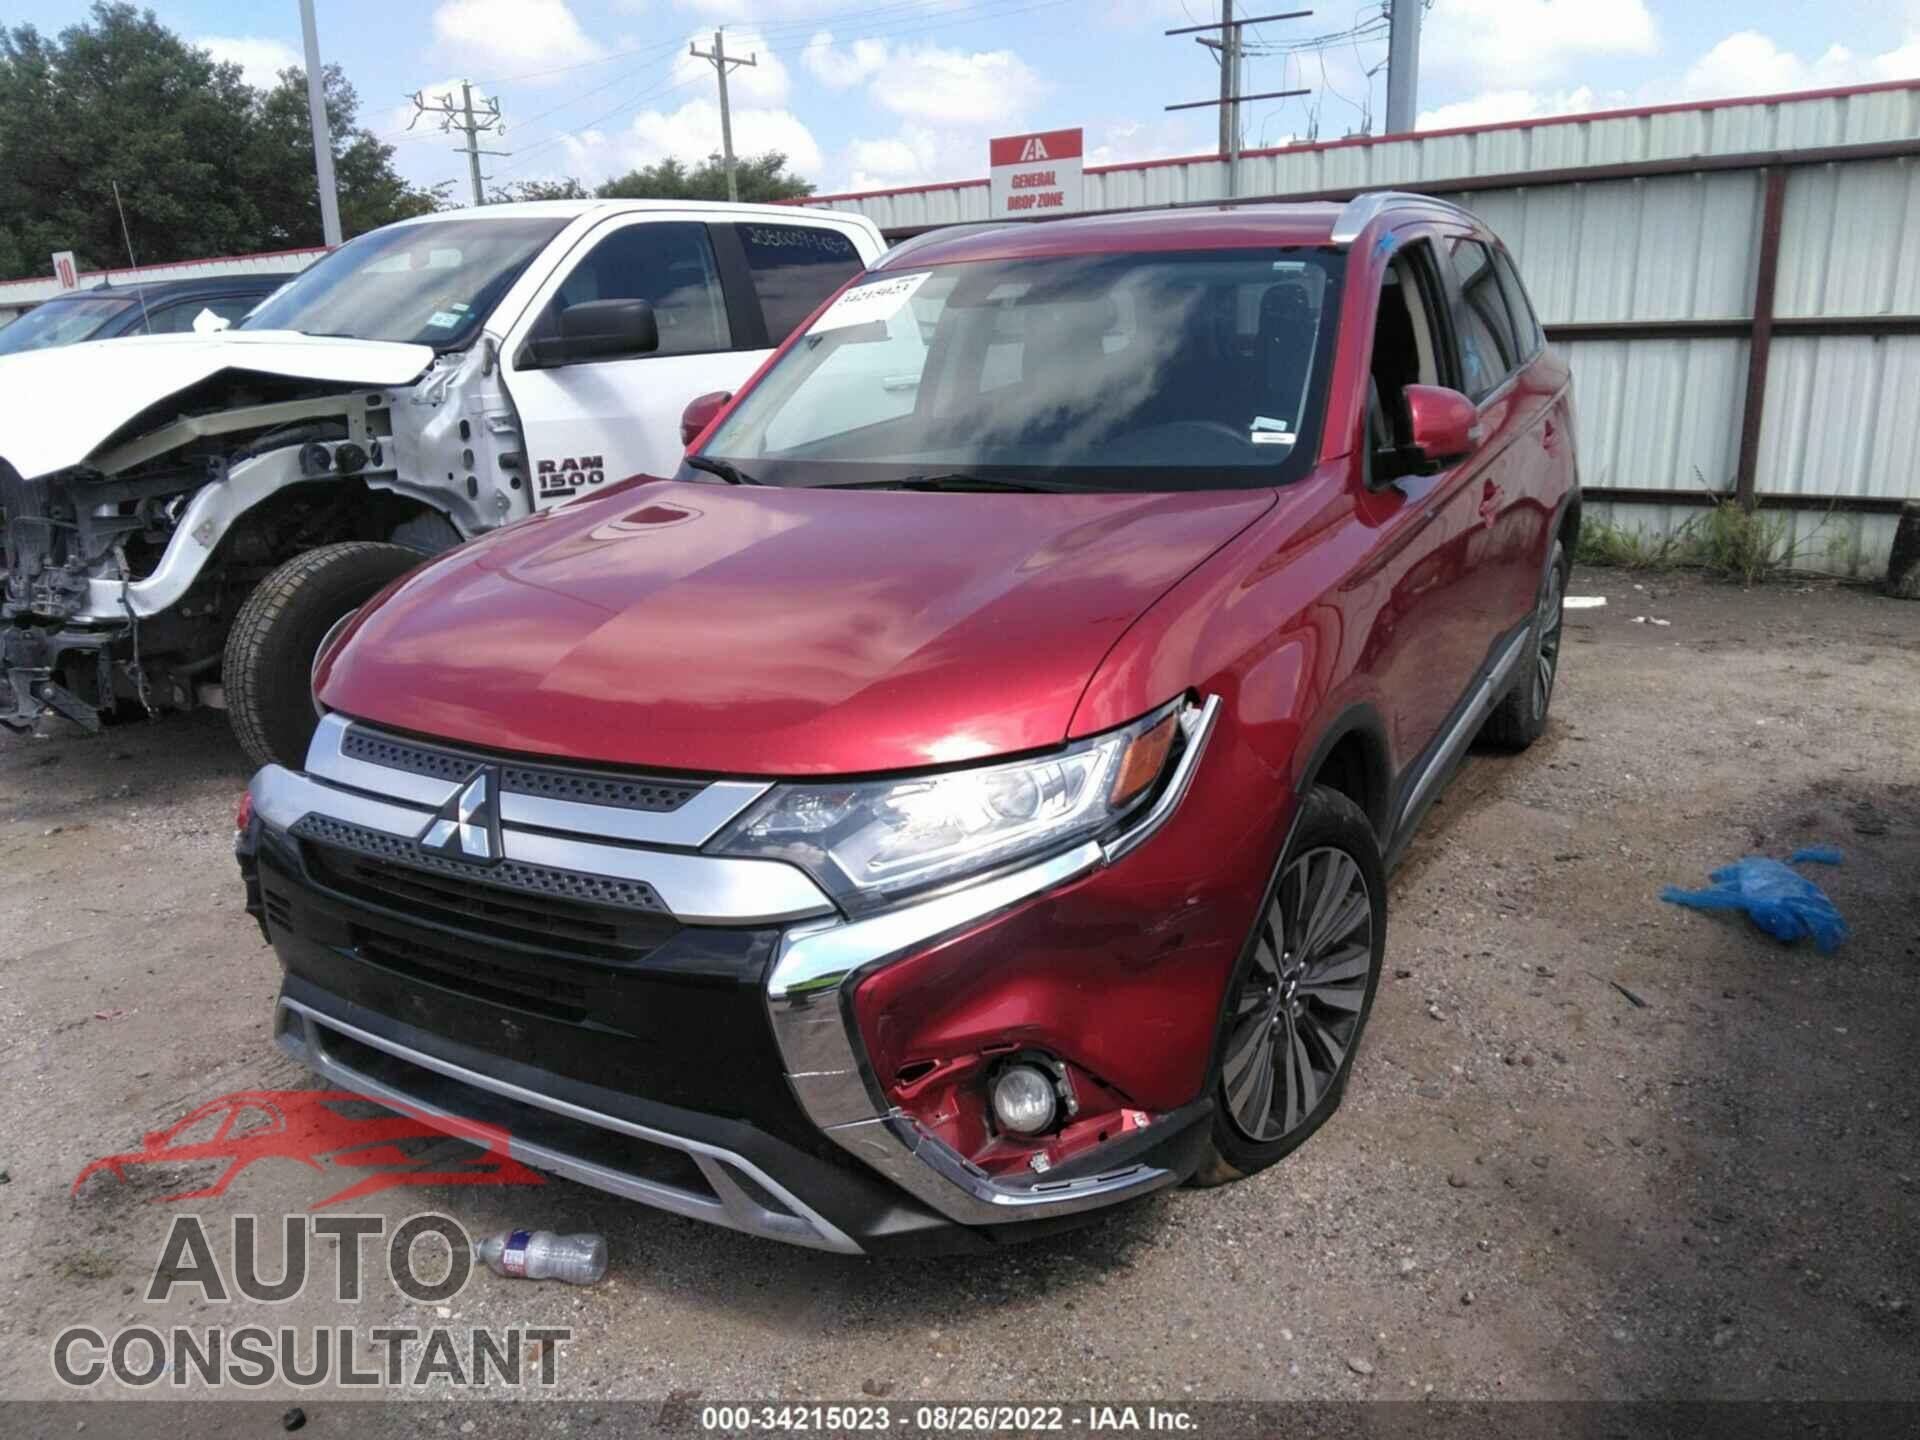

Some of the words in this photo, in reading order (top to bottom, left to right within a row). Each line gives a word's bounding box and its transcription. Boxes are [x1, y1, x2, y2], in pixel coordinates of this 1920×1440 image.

[1012, 170, 1056, 189] GENERAL
[1007, 194, 1036, 211] DROP
[1038, 191, 1064, 208] ZONE
[56, 258, 75, 288] 10
[537, 456, 604, 474] RAM
[538, 470, 605, 489] 1500
